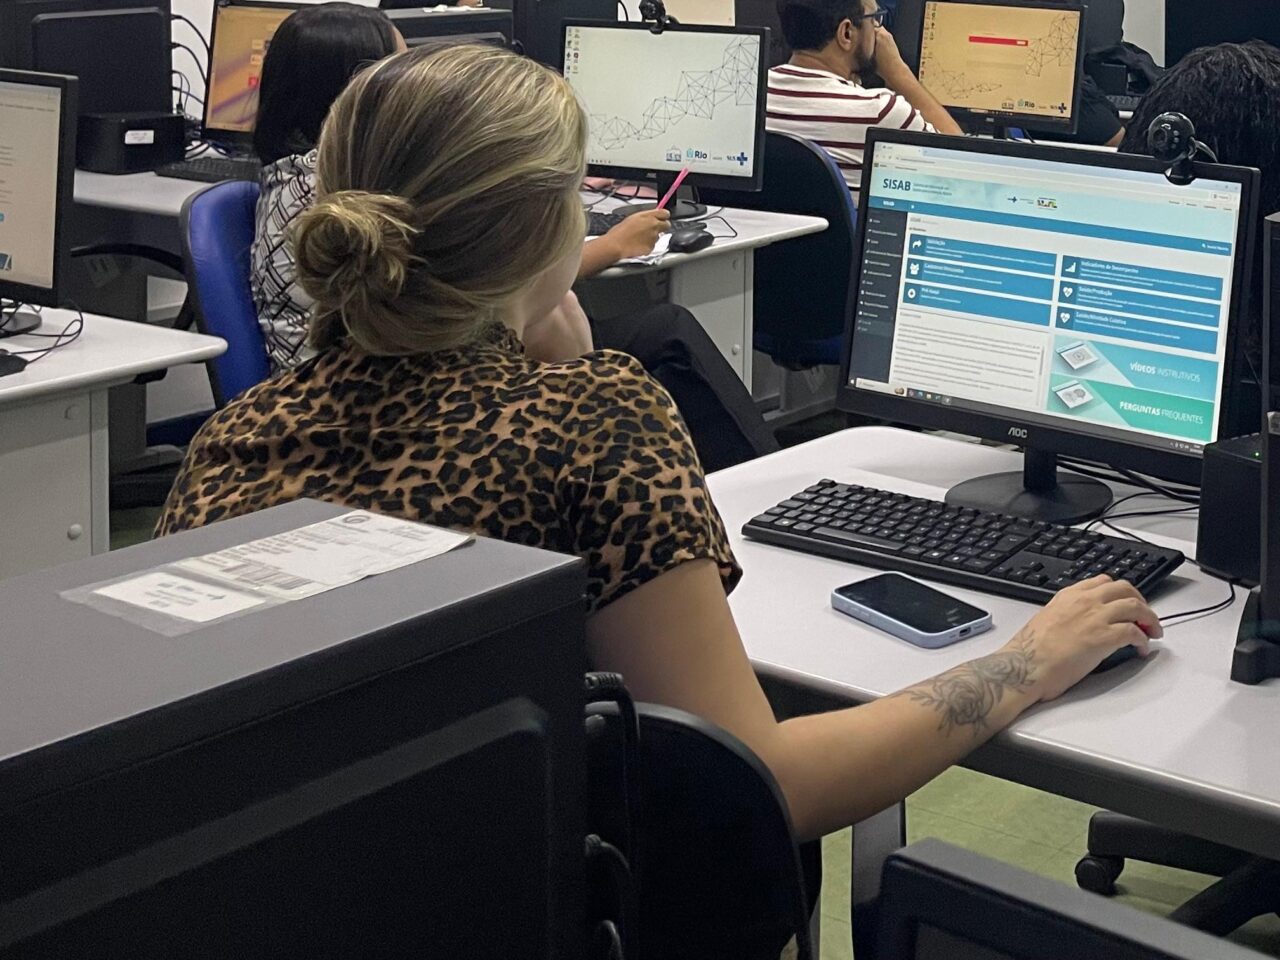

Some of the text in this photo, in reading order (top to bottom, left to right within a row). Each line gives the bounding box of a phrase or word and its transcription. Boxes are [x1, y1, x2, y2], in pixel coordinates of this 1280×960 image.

[1024, 100, 1035, 108] Rio
[694, 150, 708, 160] Rio
[883, 178, 911, 192] SISAB
[1130, 362, 1200, 382] VÍDEOS INSTRUTIVOS
[1120, 401, 1204, 424] PERGUNTAS FREQUENTES
[1008, 427, 1028, 438] AOC
